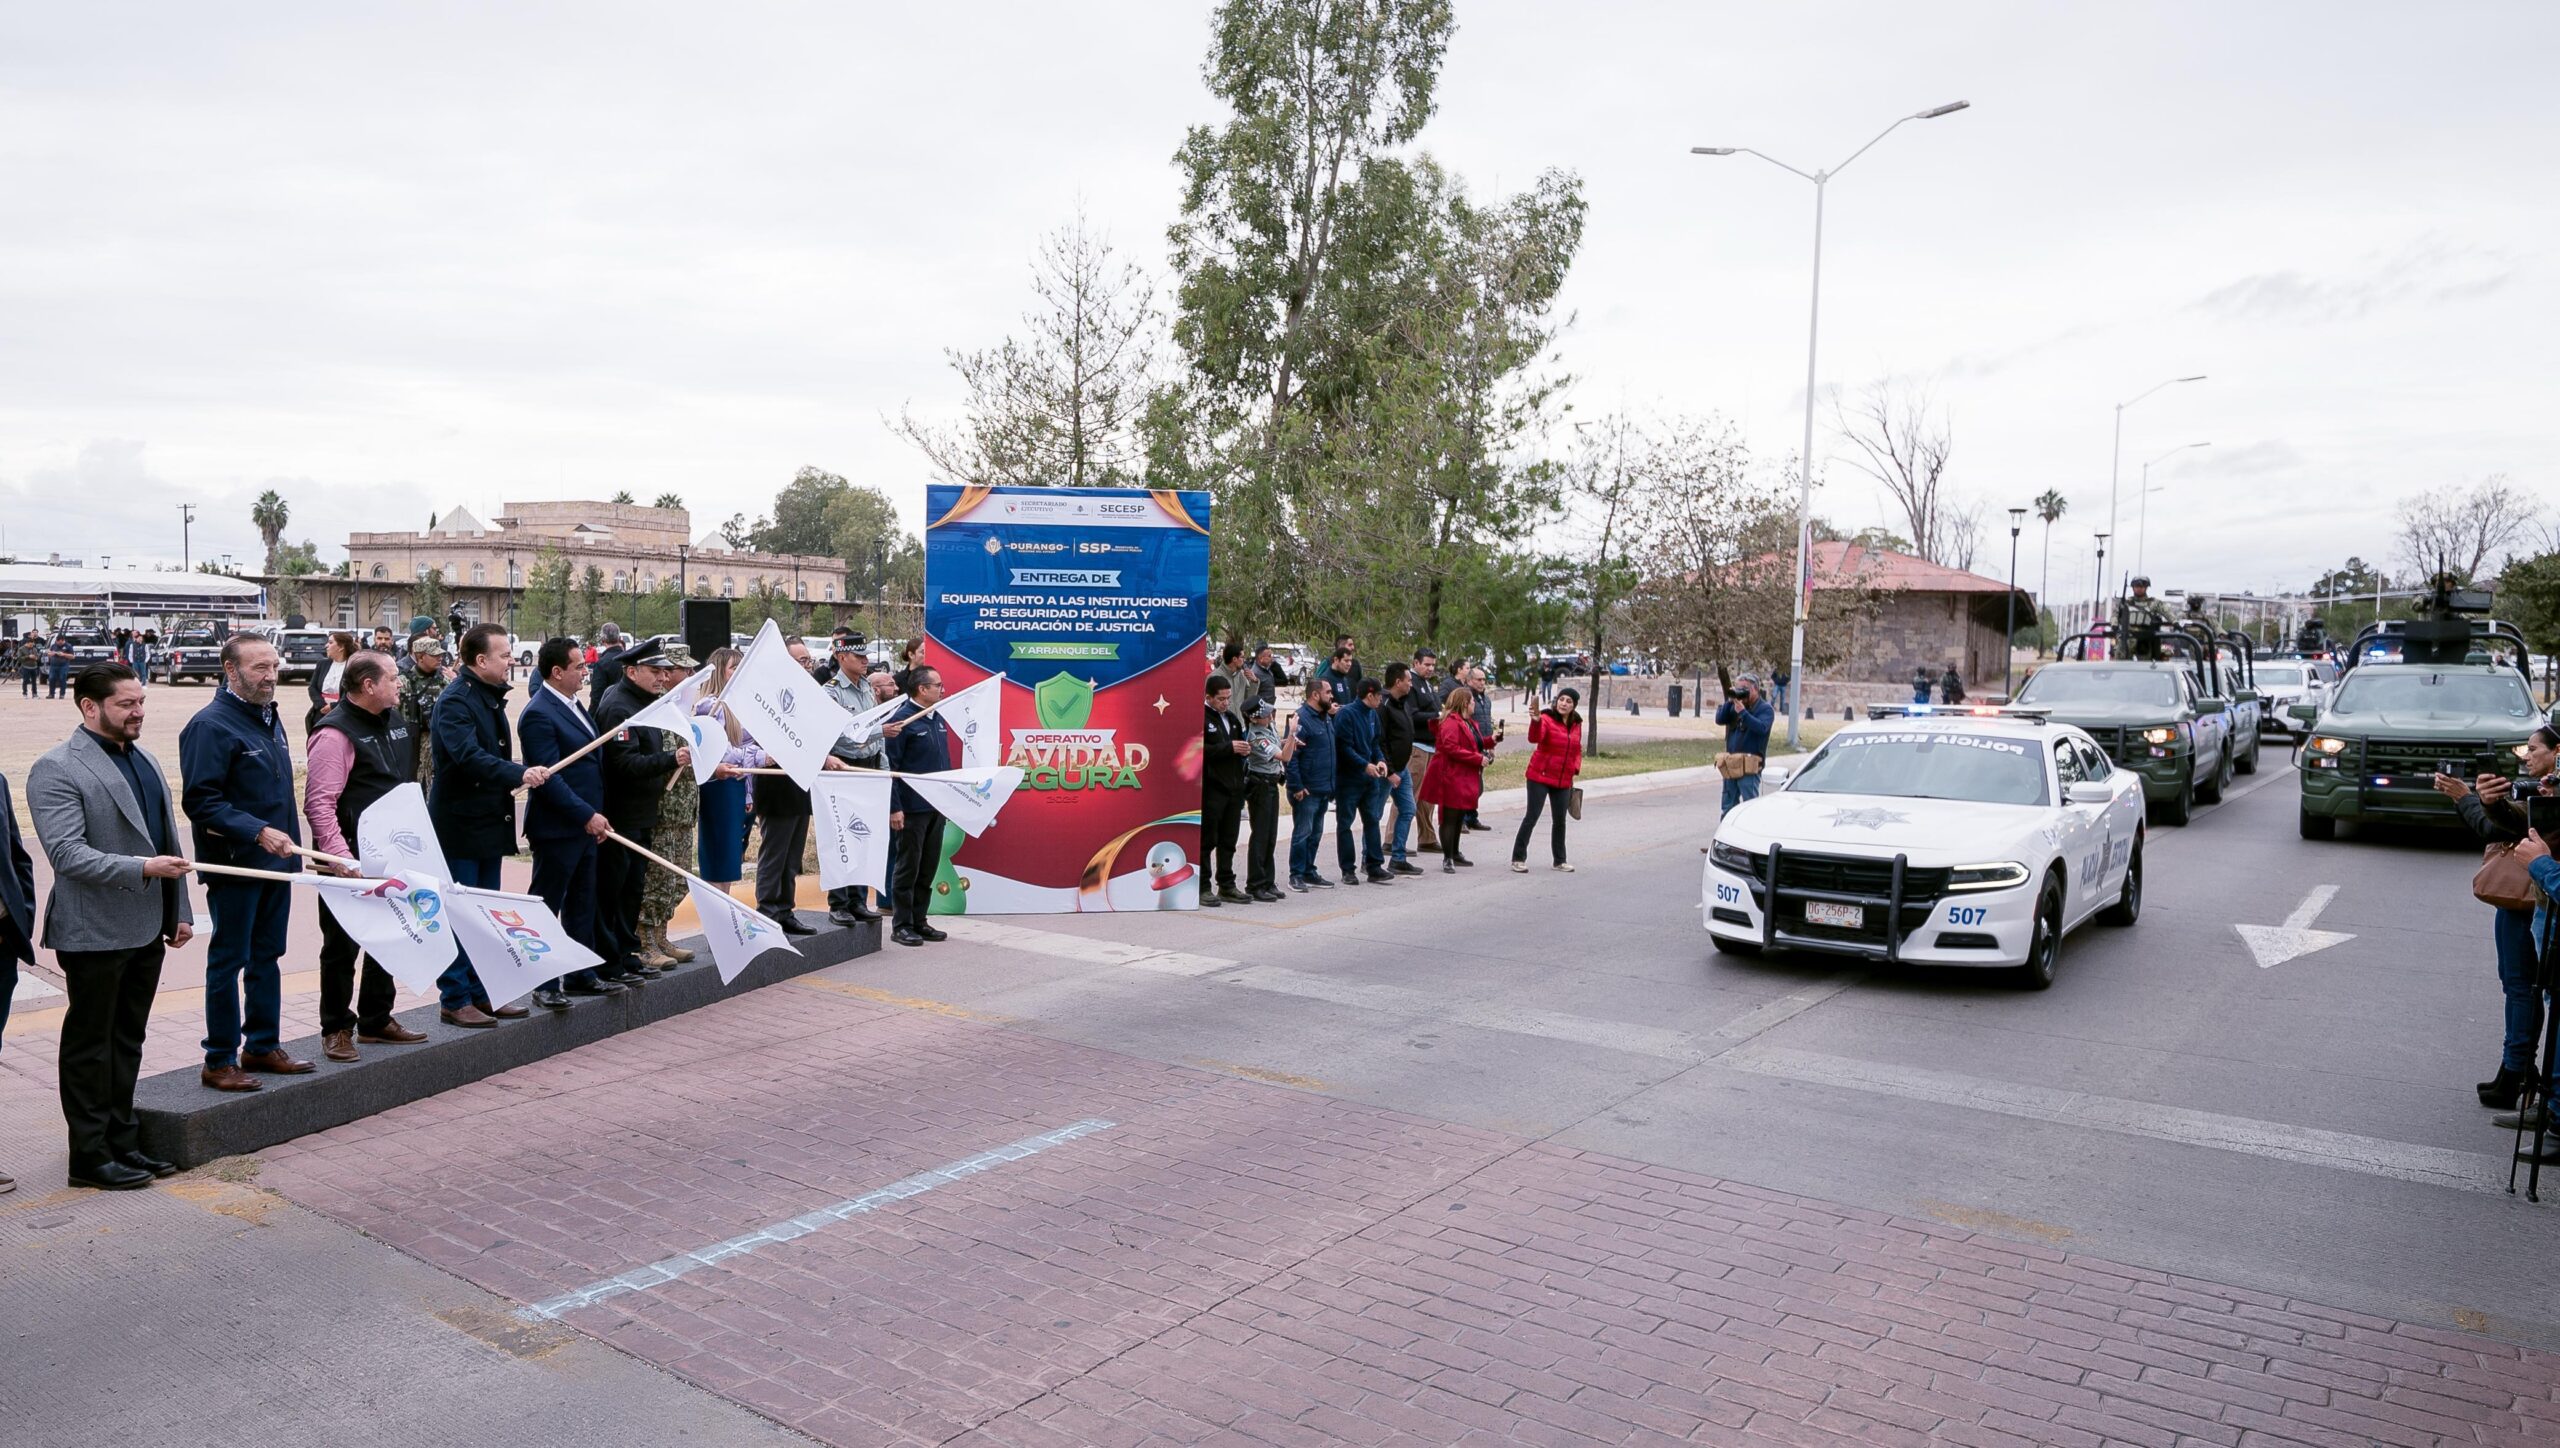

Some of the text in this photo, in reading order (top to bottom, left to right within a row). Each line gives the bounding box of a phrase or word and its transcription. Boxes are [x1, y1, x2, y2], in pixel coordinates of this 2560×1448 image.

[1100, 504, 1145, 513] SECESP
[1010, 542, 1064, 552] DURANGO
[1079, 542, 1111, 553] SSP
[1020, 572, 1111, 584] ENTREGA DE
[941, 593, 1188, 608] EQUIPAMIENTO A LAS INSTITUCIONES
[979, 606, 1151, 620] DE SEGURIDAD PÚBLICA Y
[974, 618, 1155, 633] PROCURACIÓN DE JUSTICIA
[1018, 646, 1111, 656] Y ARRANQUE DEL
[754, 693, 803, 749] DURANGO
[1025, 734, 1102, 744] OPERATIVO
[997, 743, 1150, 772] AVIDAD
[1015, 765, 1142, 789] EGURA
[830, 795, 849, 864] DURANGO
[1716, 883, 1740, 904] 507
[387, 897, 423, 945] nuestra gente
[1948, 907, 1987, 926] 507
[507, 946, 523, 968] gente
